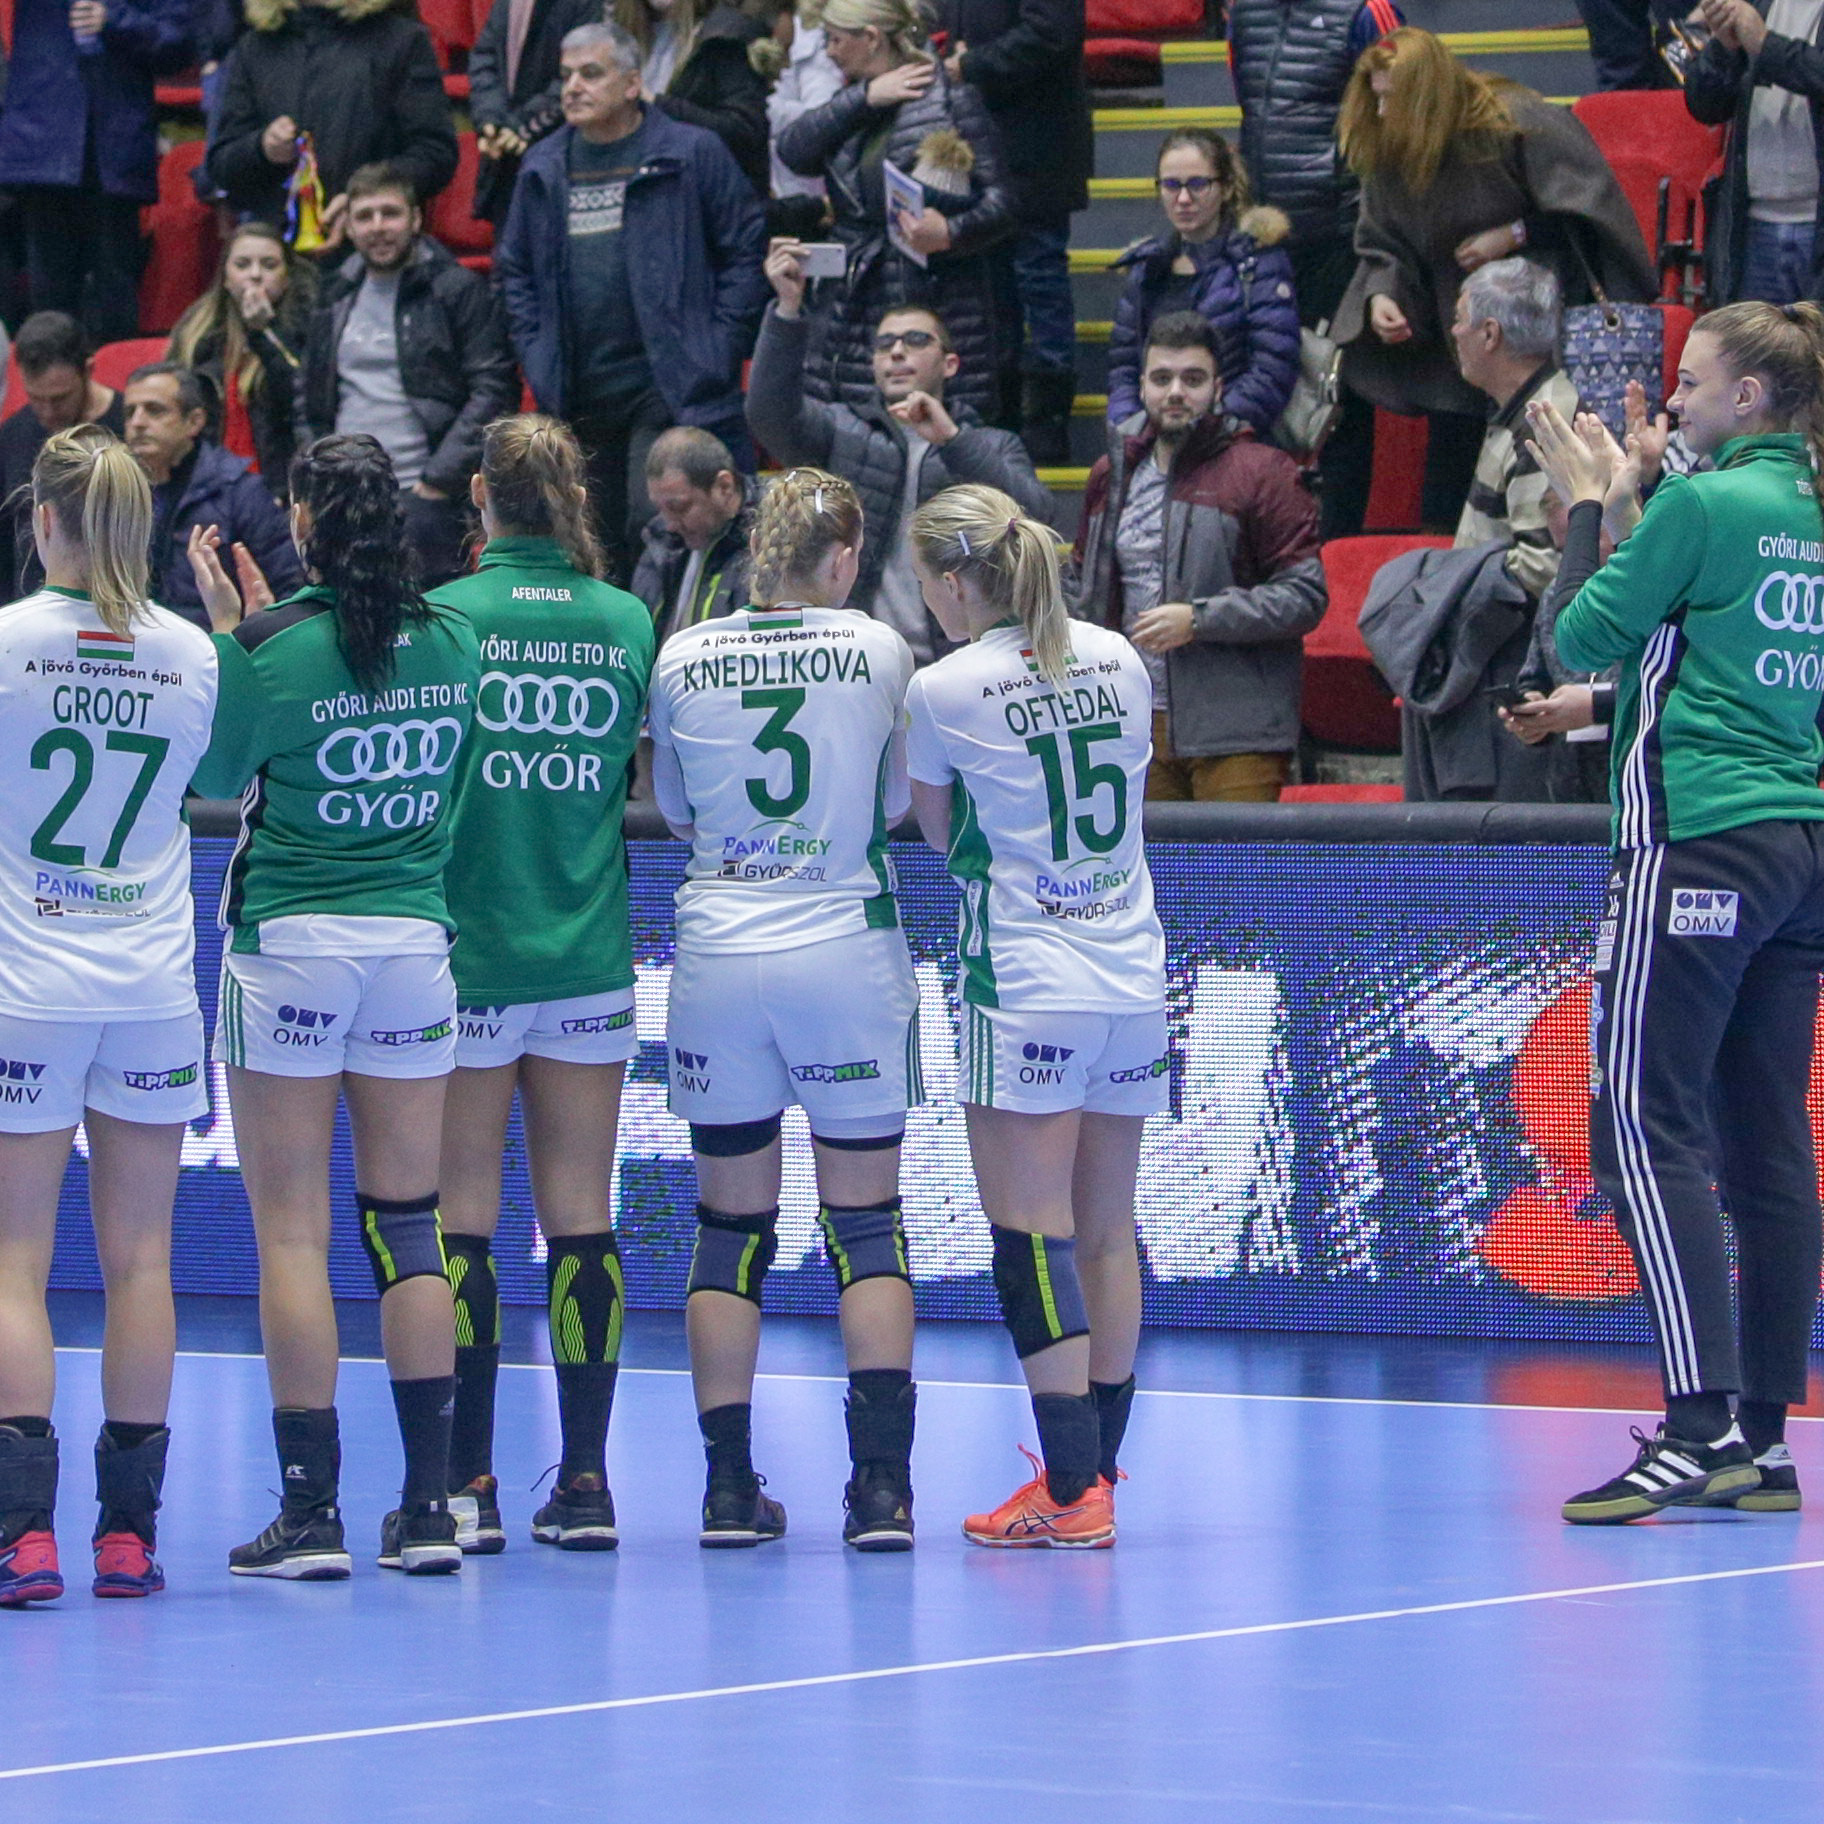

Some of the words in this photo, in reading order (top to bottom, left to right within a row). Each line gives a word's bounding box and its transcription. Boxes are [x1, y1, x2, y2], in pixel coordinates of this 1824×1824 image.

[1758, 532, 1798, 560] GYŐRI
[511, 585, 573, 603] AFENTALER
[522, 640, 568, 663] AUDI
[571, 642, 604, 665] ETO
[609, 645, 626, 670] KC
[701, 639, 711, 648] A
[25, 661, 37, 673] A
[152, 670, 183, 687] épül
[683, 647, 872, 692] KNEDLIKOVA
[53, 685, 155, 729] GROOT
[373, 686, 416, 713] AUDI
[422, 684, 449, 709] ETO
[454, 682, 468, 705] KC
[982, 686, 994, 699] A
[1005, 682, 1127, 737] OFTEDAL
[482, 743, 603, 793] GYŐR
[741, 687, 811, 818] 3
[30, 727, 170, 868] 27
[317, 784, 440, 829] GYŐR
[1025, 722, 1127, 863] 15
[35, 871, 148, 904] PANNERGY
[1036, 867, 1131, 898] PANNERGY
[1674, 915, 1731, 933] OMV
[273, 1029, 329, 1047] OMV
[1019, 1067, 1067, 1085] OMV
